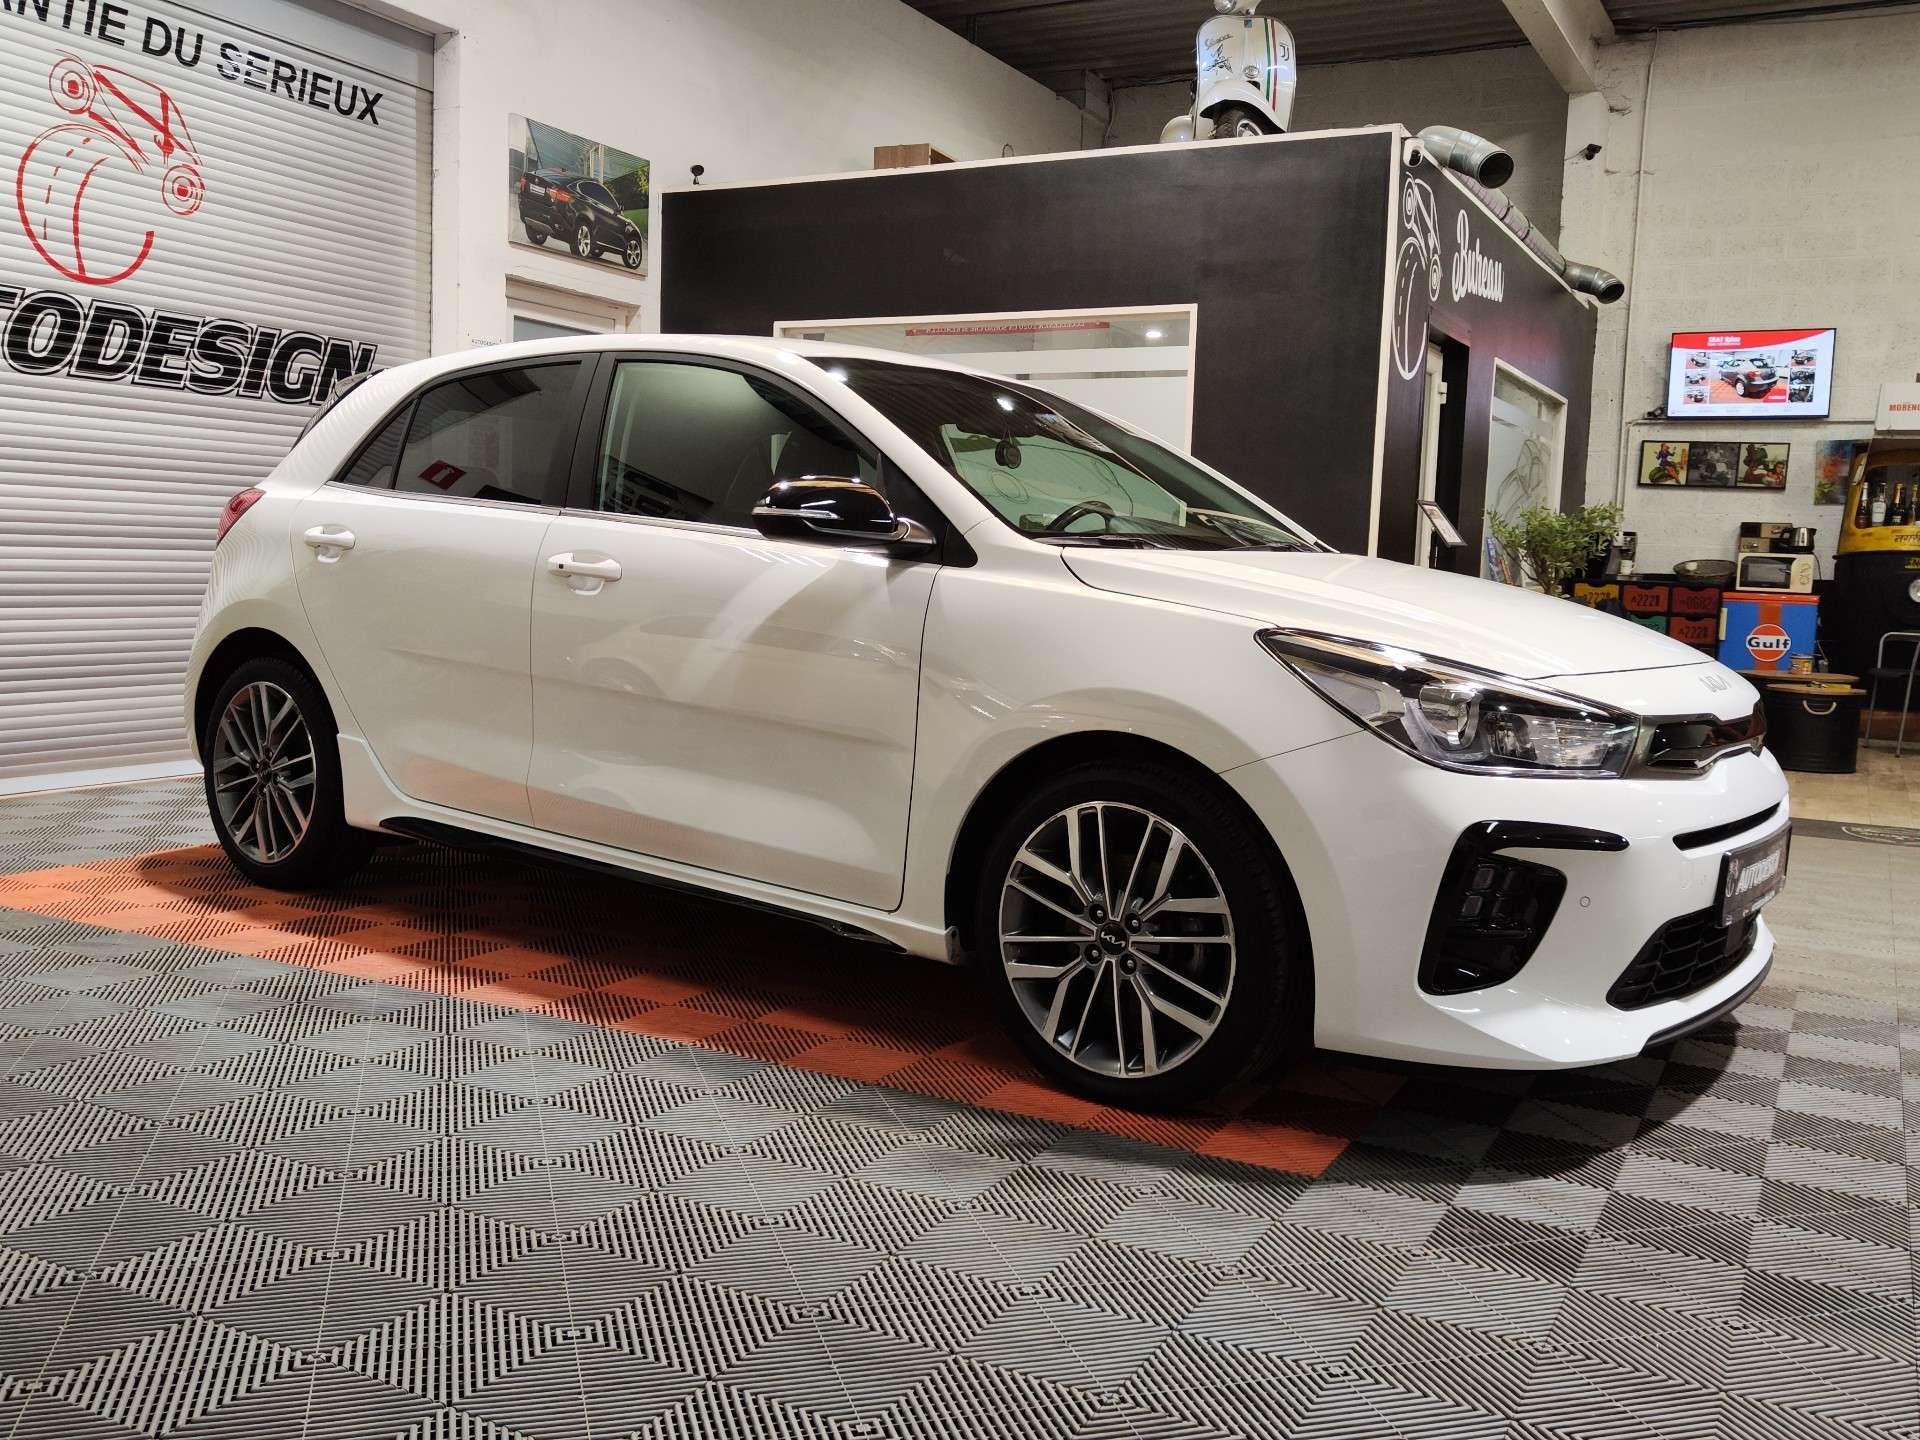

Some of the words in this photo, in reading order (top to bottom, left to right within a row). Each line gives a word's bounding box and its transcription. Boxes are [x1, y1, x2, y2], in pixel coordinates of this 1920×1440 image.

[0, 0, 129, 46] TIE
[142, 16, 204, 67] DU
[217, 42, 383, 126] SERIEUX
[1748, 636, 1791, 649] Gulf
